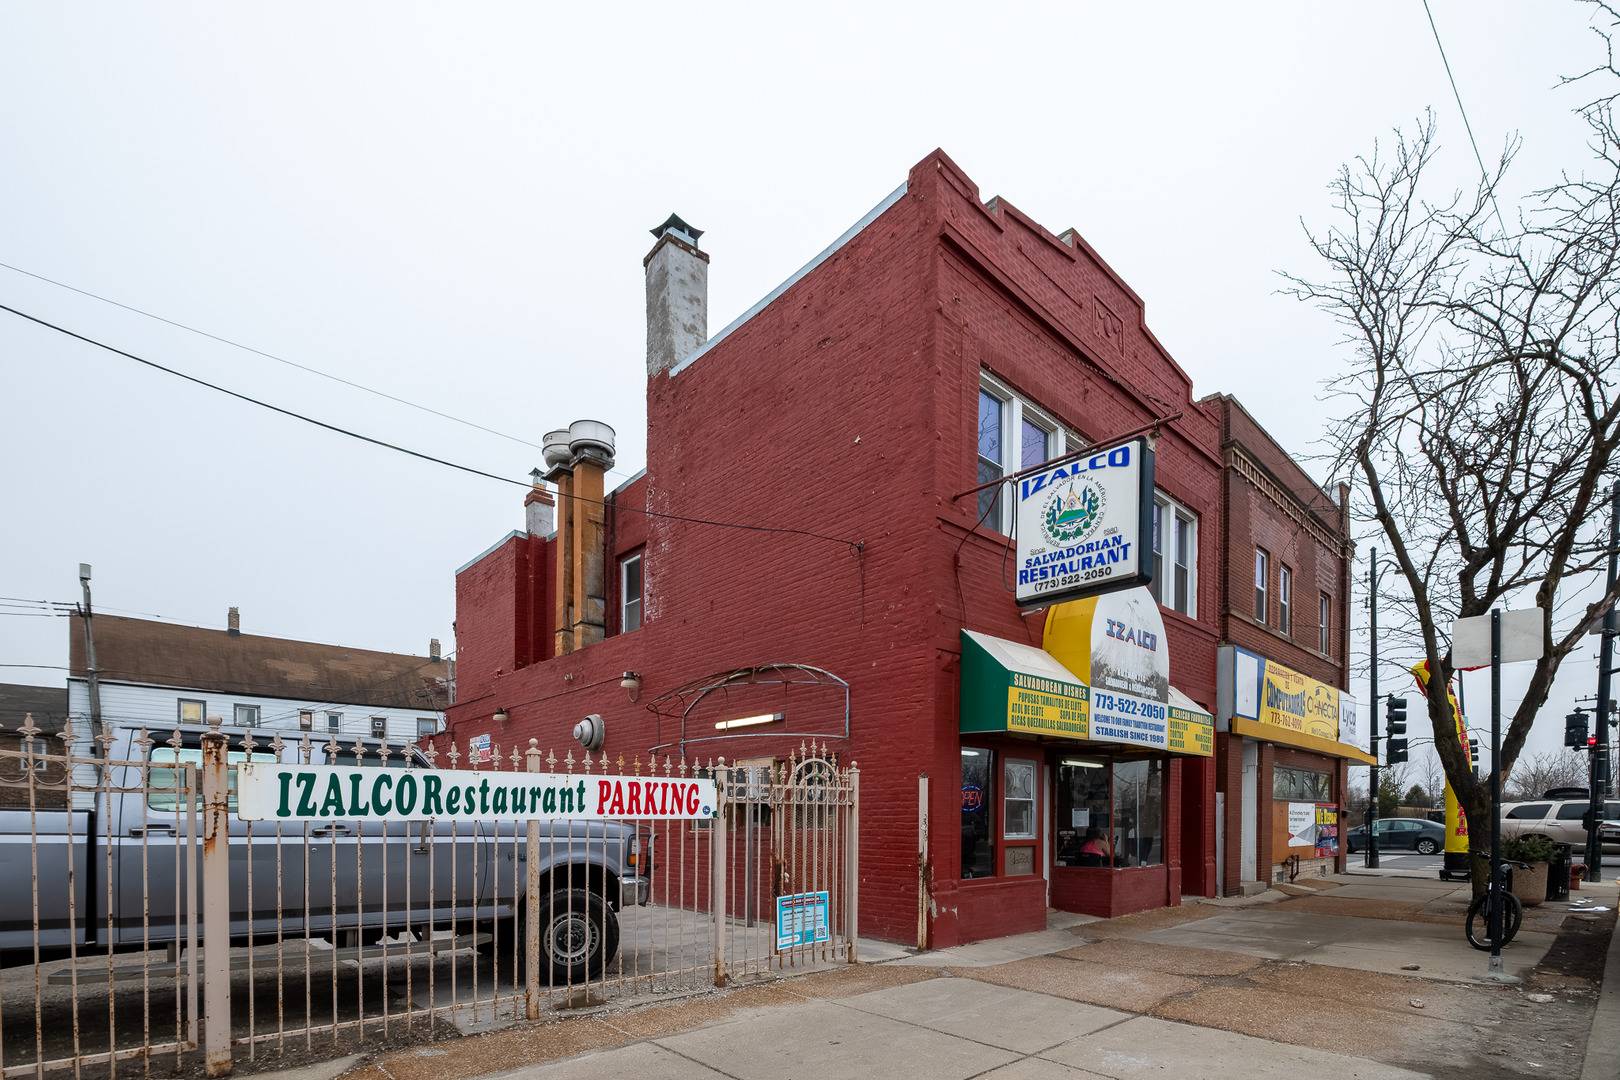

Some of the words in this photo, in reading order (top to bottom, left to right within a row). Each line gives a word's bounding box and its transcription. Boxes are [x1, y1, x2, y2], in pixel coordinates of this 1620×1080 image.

[1022, 446, 1130, 502] IZALCO
[1047, 476, 1075, 499] SALVADOR
[1019, 542, 1131, 585] RESTAURANT
[1025, 534, 1123, 568] SALVADORIAN
[1034, 577, 1059, 593] (773)
[1061, 566, 1112, 588] 522-2050
[1063, 684, 1087, 700] DISHES
[1095, 693, 1165, 720] 773-522-2050
[1095, 726, 1128, 739] STABLISH
[1129, 731, 1148, 742] SINCE
[1149, 734, 1164, 743] 1980
[277, 772, 418, 817] IZALCO
[422, 774, 586, 817] Restaurant
[597, 779, 701, 816] PARKING
